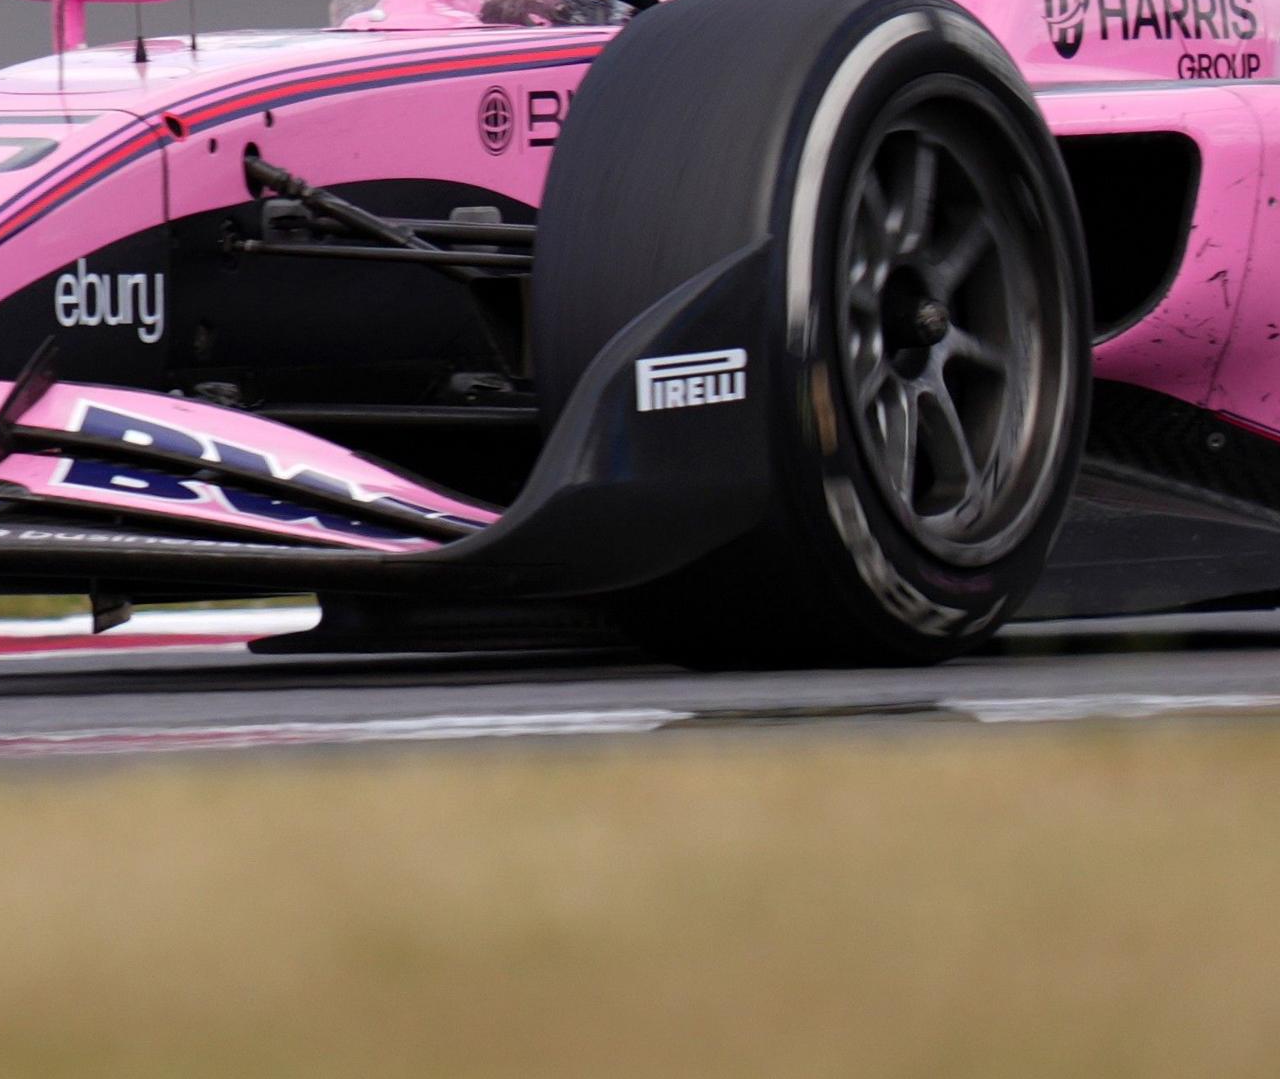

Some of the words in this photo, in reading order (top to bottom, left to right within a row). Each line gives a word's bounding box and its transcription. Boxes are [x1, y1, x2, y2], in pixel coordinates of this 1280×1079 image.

[1176, 52, 1261, 80] GROUP
[55, 258, 164, 344] ebury
[635, 348, 747, 411] PIRELLI
